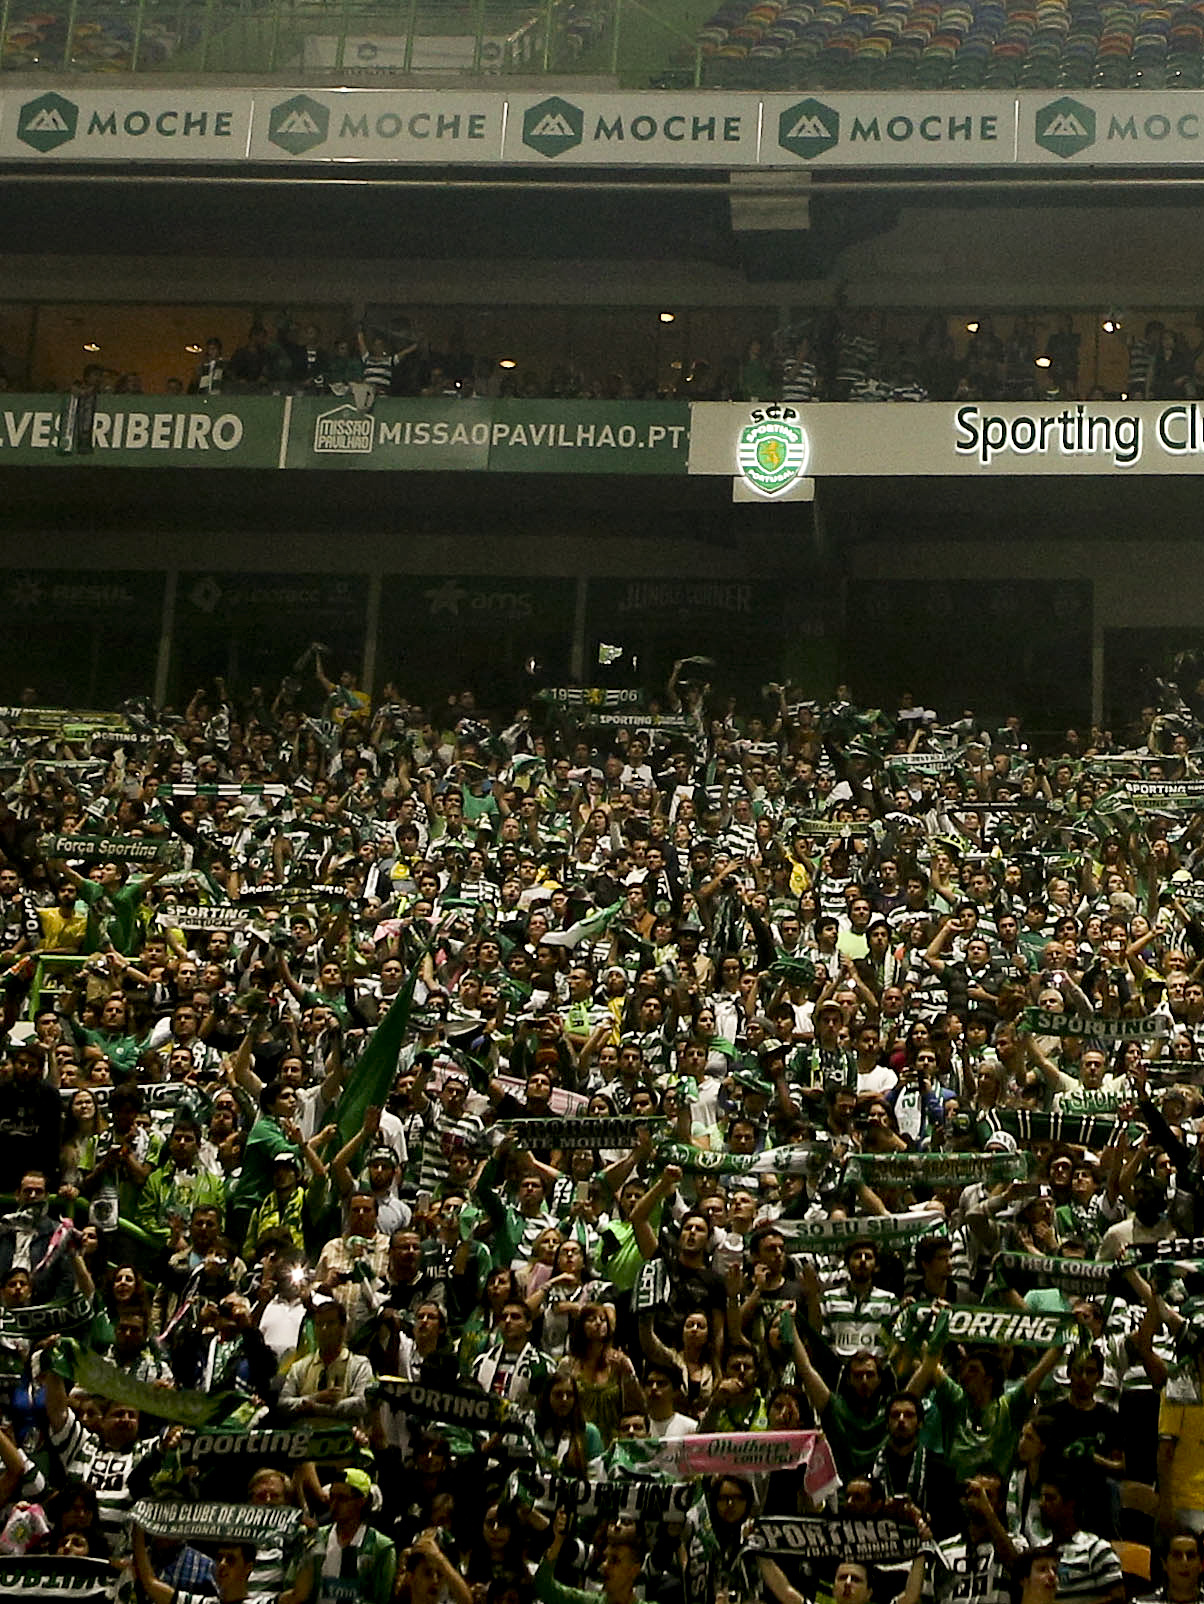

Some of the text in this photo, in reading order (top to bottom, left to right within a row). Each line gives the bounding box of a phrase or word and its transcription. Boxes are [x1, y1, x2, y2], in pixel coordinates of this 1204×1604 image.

[88, 110, 232, 138] MOCHE
[339, 112, 486, 139] MOCHE
[594, 115, 742, 142] MOCHE
[849, 114, 998, 142] MOCHE
[751, 405, 797, 423] SCP
[93, 414, 244, 450] RIBEIRO
[955, 405, 1141, 464] Sporting
[98, 840, 158, 858] Sporting
[166, 905, 250, 920] SPORTING
[1038, 1012, 1157, 1036] SPORTING
[178, 1504, 216, 1523] CLUBE
[218, 1507, 236, 1524] DE
